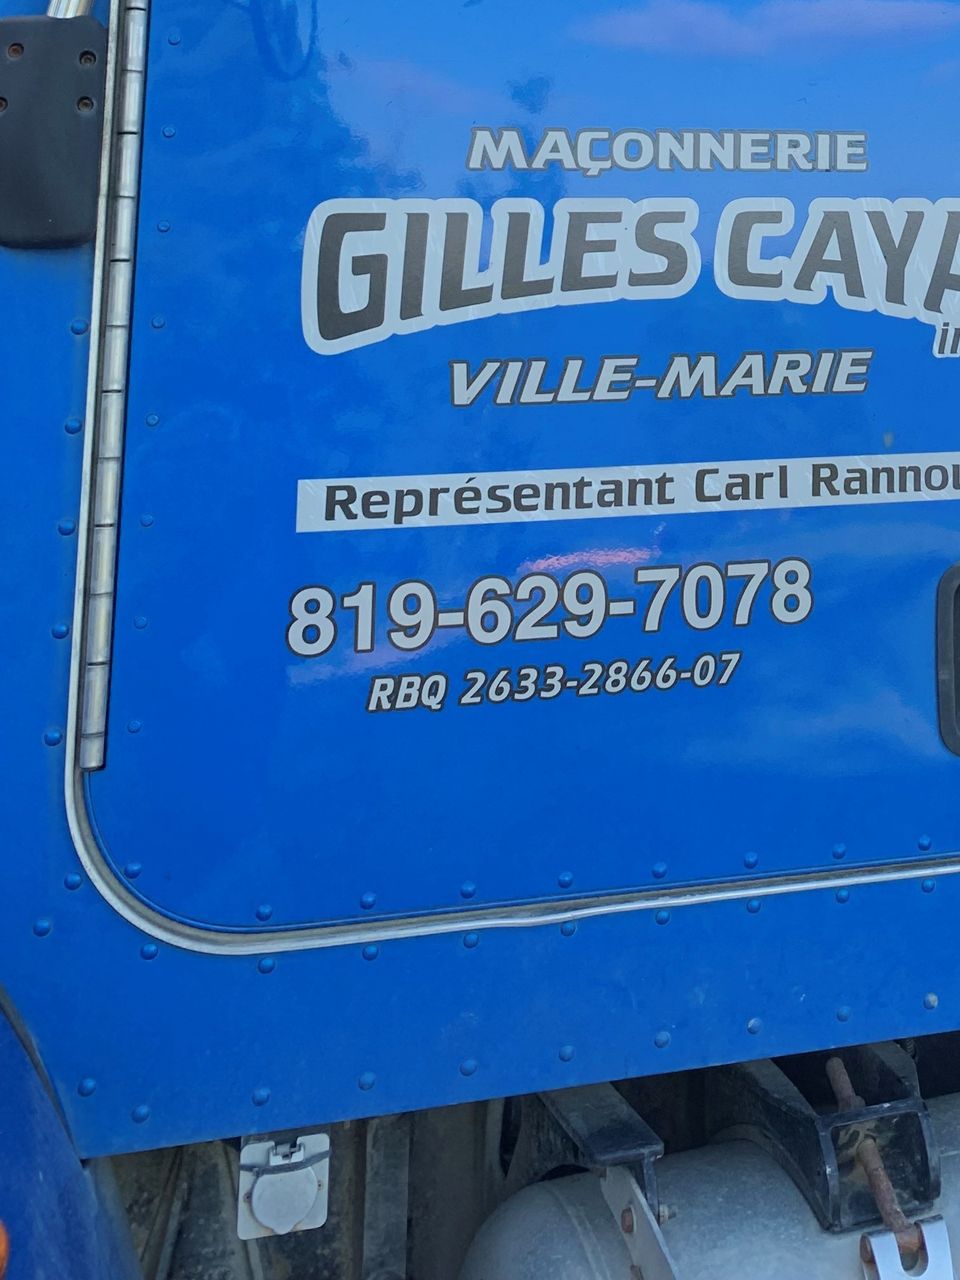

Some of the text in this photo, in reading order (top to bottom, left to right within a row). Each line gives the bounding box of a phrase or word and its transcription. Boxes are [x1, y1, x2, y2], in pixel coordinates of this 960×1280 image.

[468, 128, 868, 175] MAÇONNERIE
[310, 204, 696, 347] GILLES
[448, 349, 873, 407] VILLE-MARIE
[324, 472, 676, 524] Représentant
[694, 464, 789, 502] Carl
[285, 558, 813, 657] 819-629-7078
[366, 651, 742, 714] RBQ 2633-2866-07
